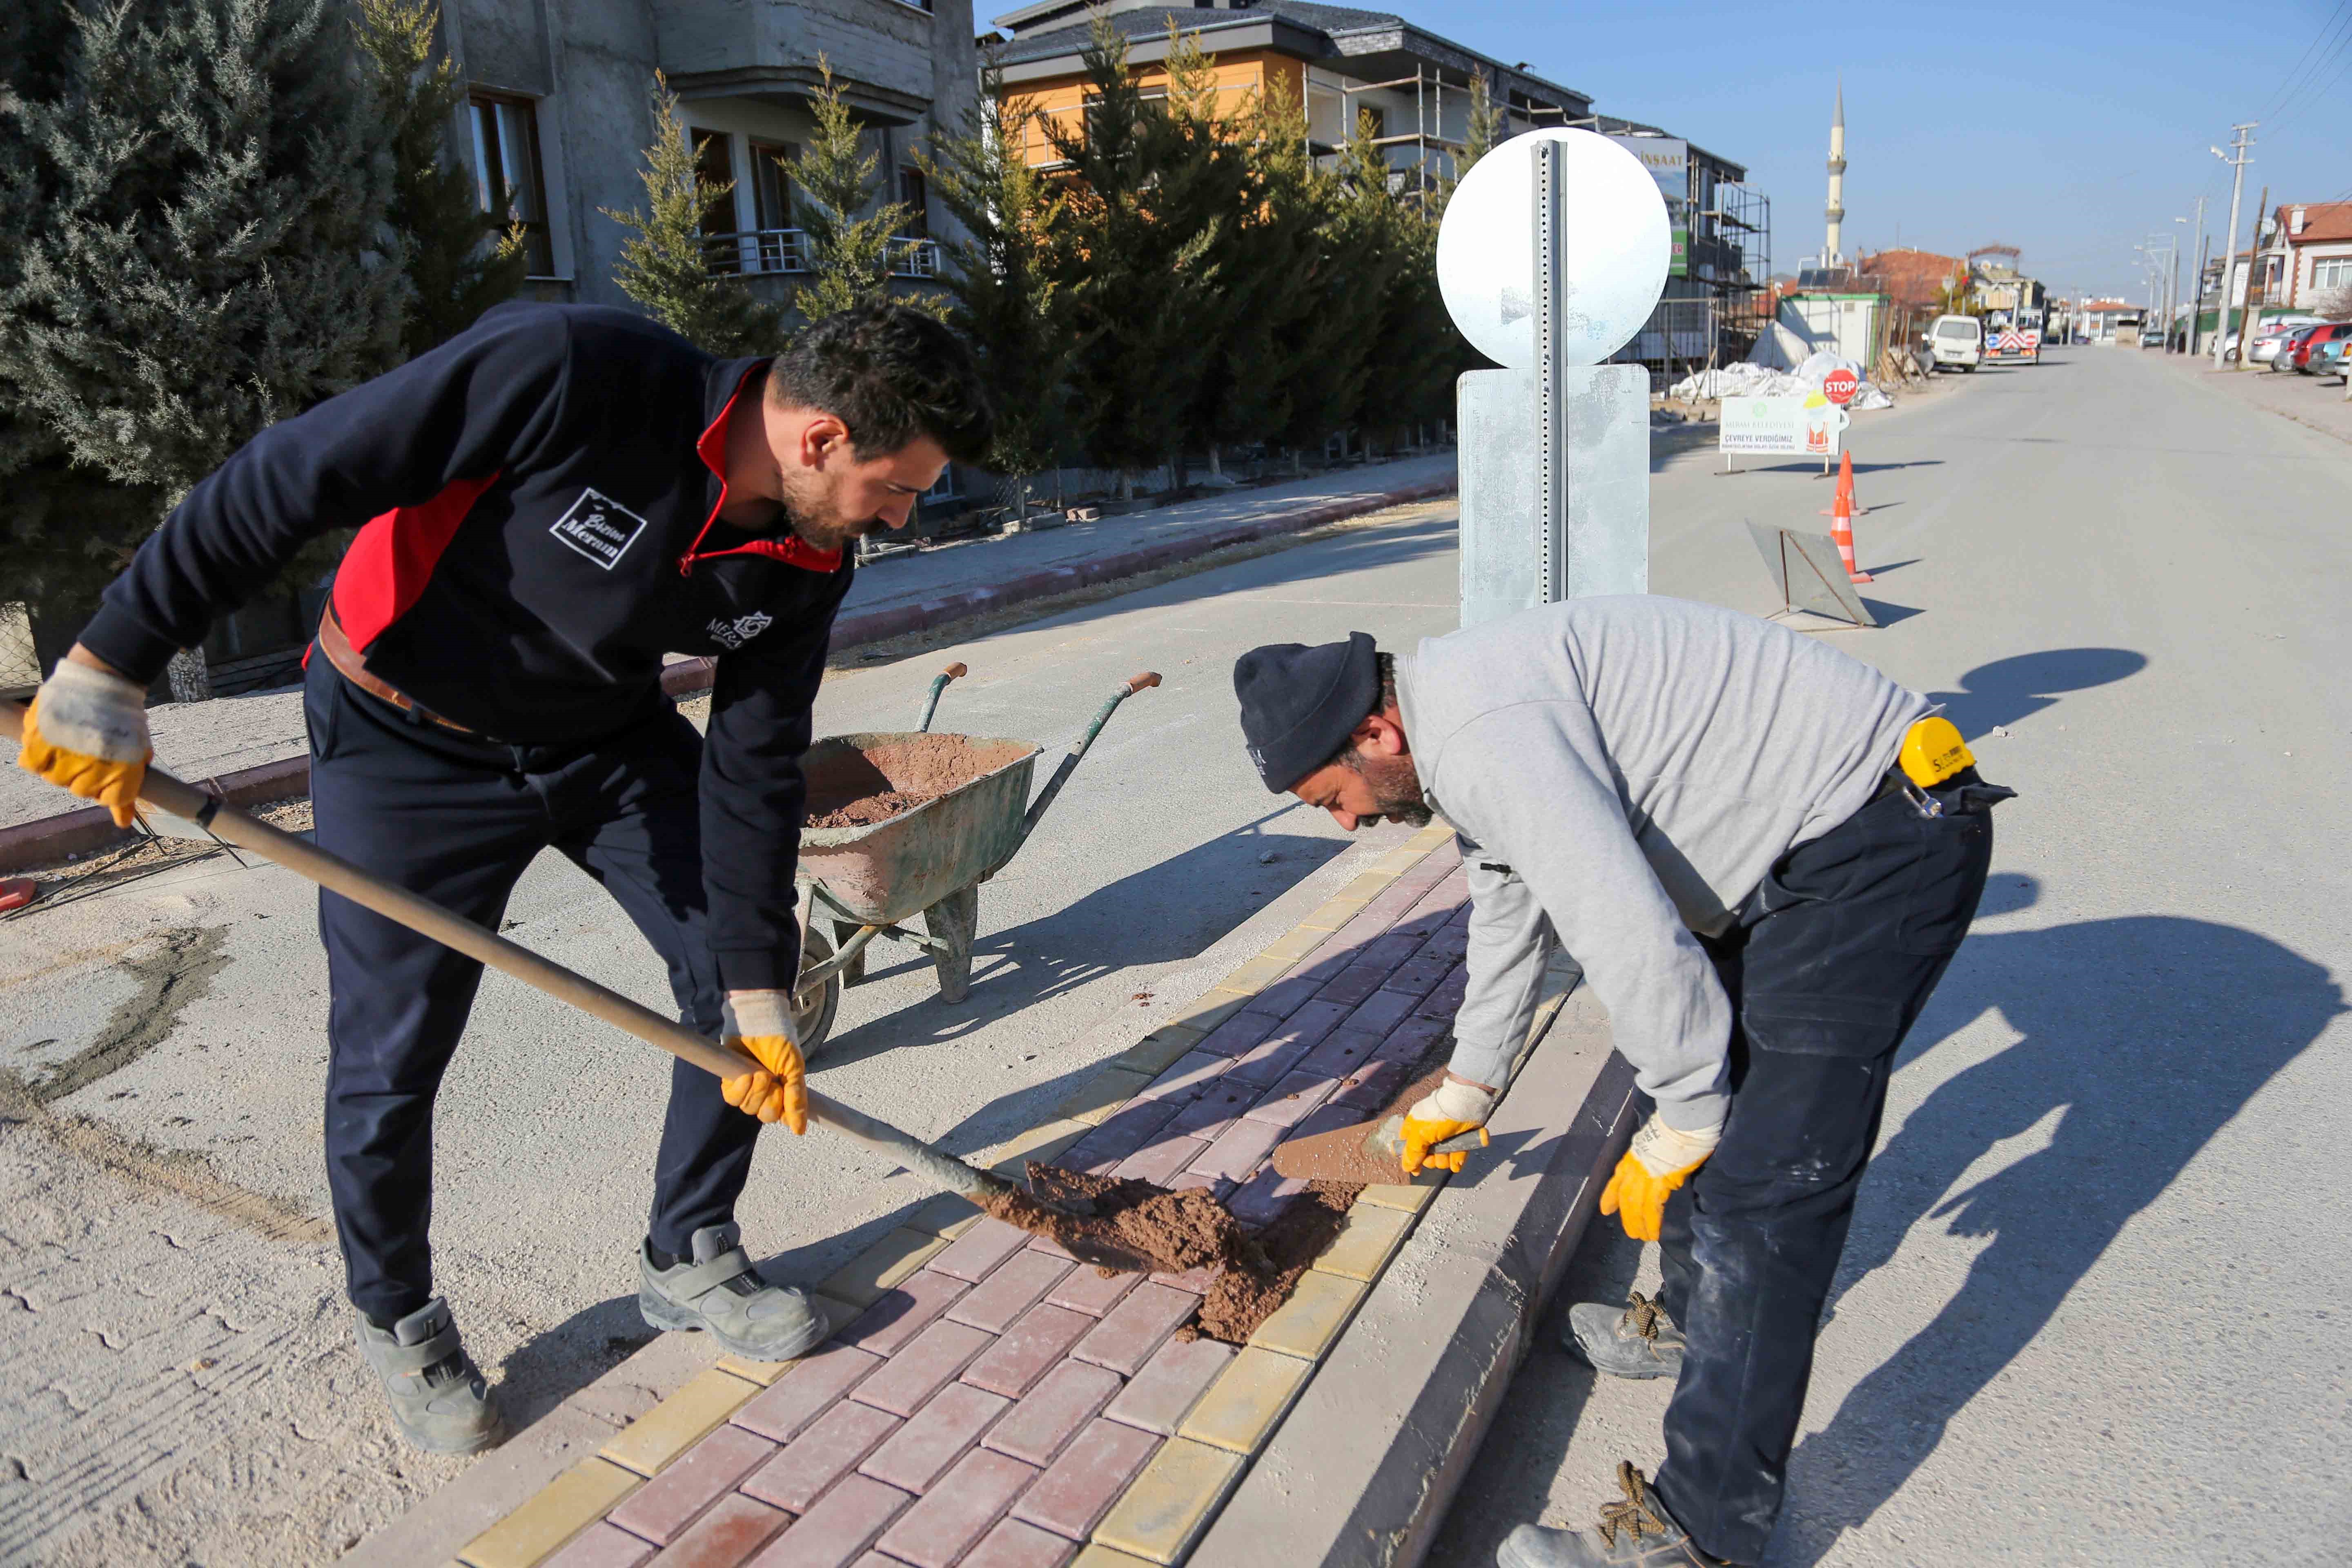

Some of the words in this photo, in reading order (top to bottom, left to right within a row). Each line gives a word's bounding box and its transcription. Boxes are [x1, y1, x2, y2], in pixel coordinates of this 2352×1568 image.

[1640, 150, 1682, 167] İNŞAAT
[1826, 381, 1855, 392] STOP
[1725, 434, 1751, 442] ÇEVREYE
[1755, 433, 1793, 442] VERDİĞİMİZ
[561, 518, 619, 558] Meram
[706, 617, 742, 648] MERA
